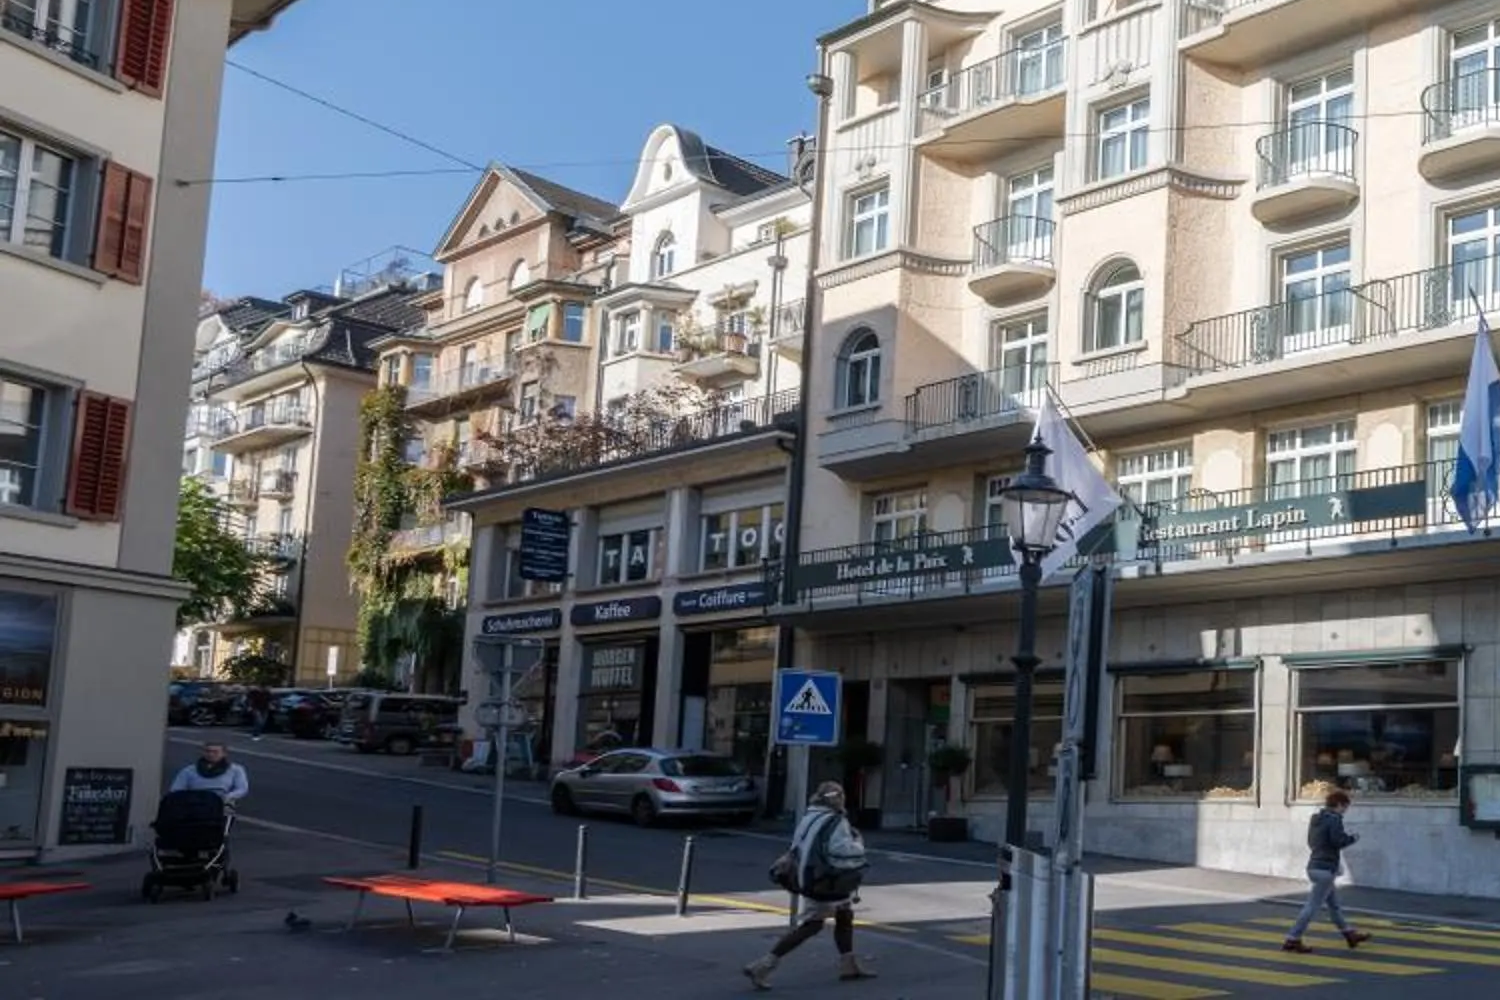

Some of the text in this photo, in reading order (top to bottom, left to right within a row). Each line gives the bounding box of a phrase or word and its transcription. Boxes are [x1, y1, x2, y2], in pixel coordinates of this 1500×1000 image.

[1245, 504, 1306, 532] Lapin
[837, 551, 948, 579] Hotel de la Paix
[594, 602, 632, 620] Kaffee
[699, 589, 746, 609] Coiffure
